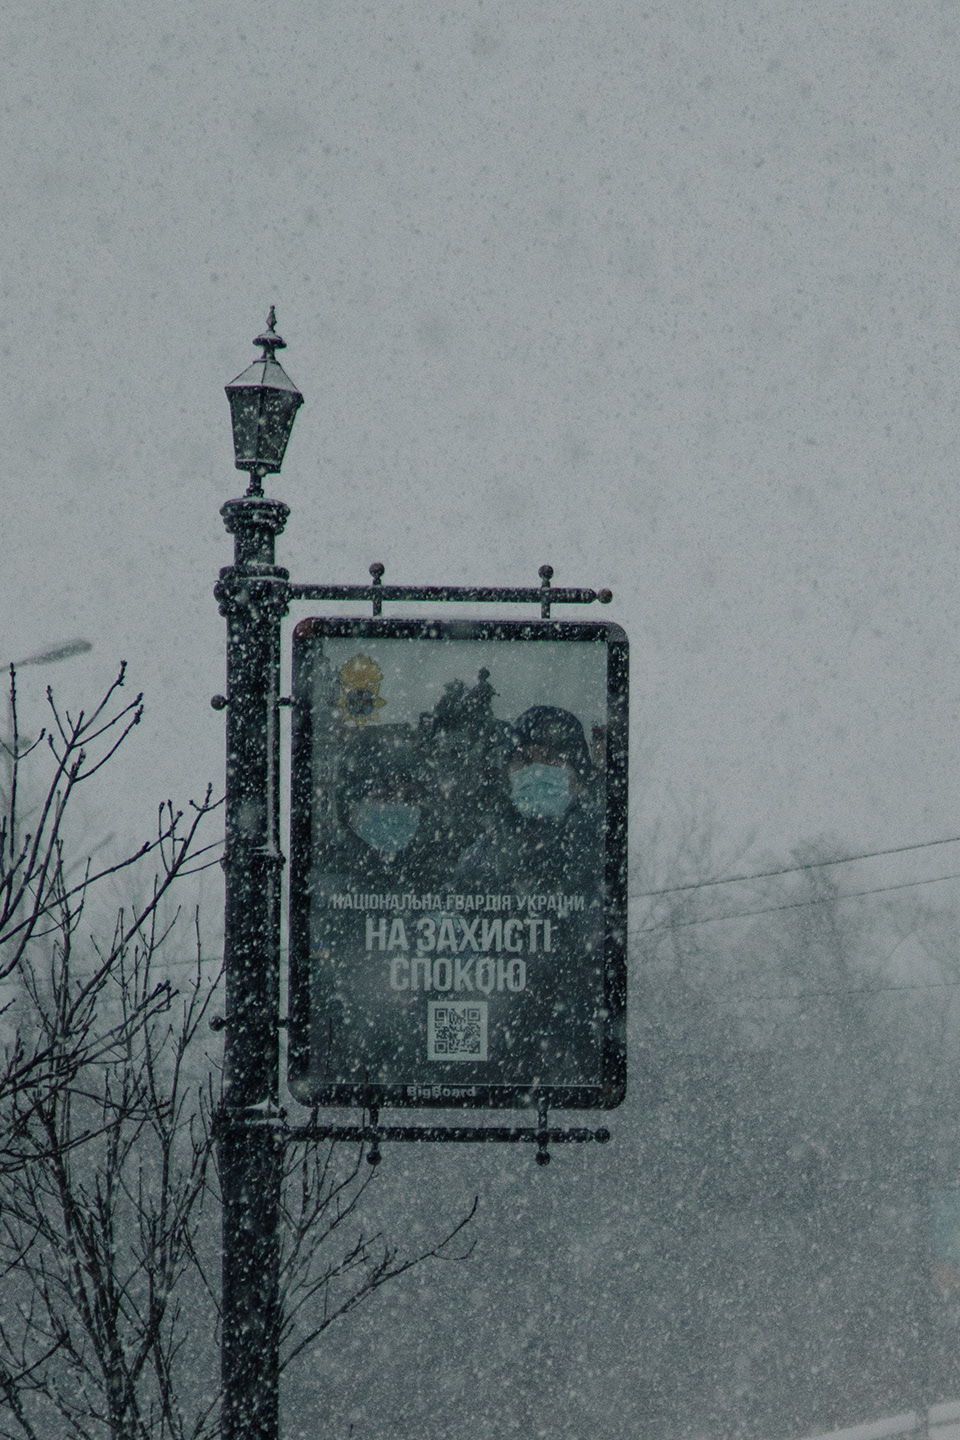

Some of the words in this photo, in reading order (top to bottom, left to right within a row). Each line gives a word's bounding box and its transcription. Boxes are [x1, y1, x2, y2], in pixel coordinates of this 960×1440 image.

[333, 894, 441, 911] НАЦІОНАЛЬНА
[447, 894, 512, 911] ГВАРДІЯ
[517, 893, 585, 911] УКРАЇНИ
[365, 918, 409, 951] НА
[417, 918, 551, 952] ЗАХИСТІ
[390, 957, 527, 992] СПОКОЮ
[406, 1085, 477, 1099] BigBoard
